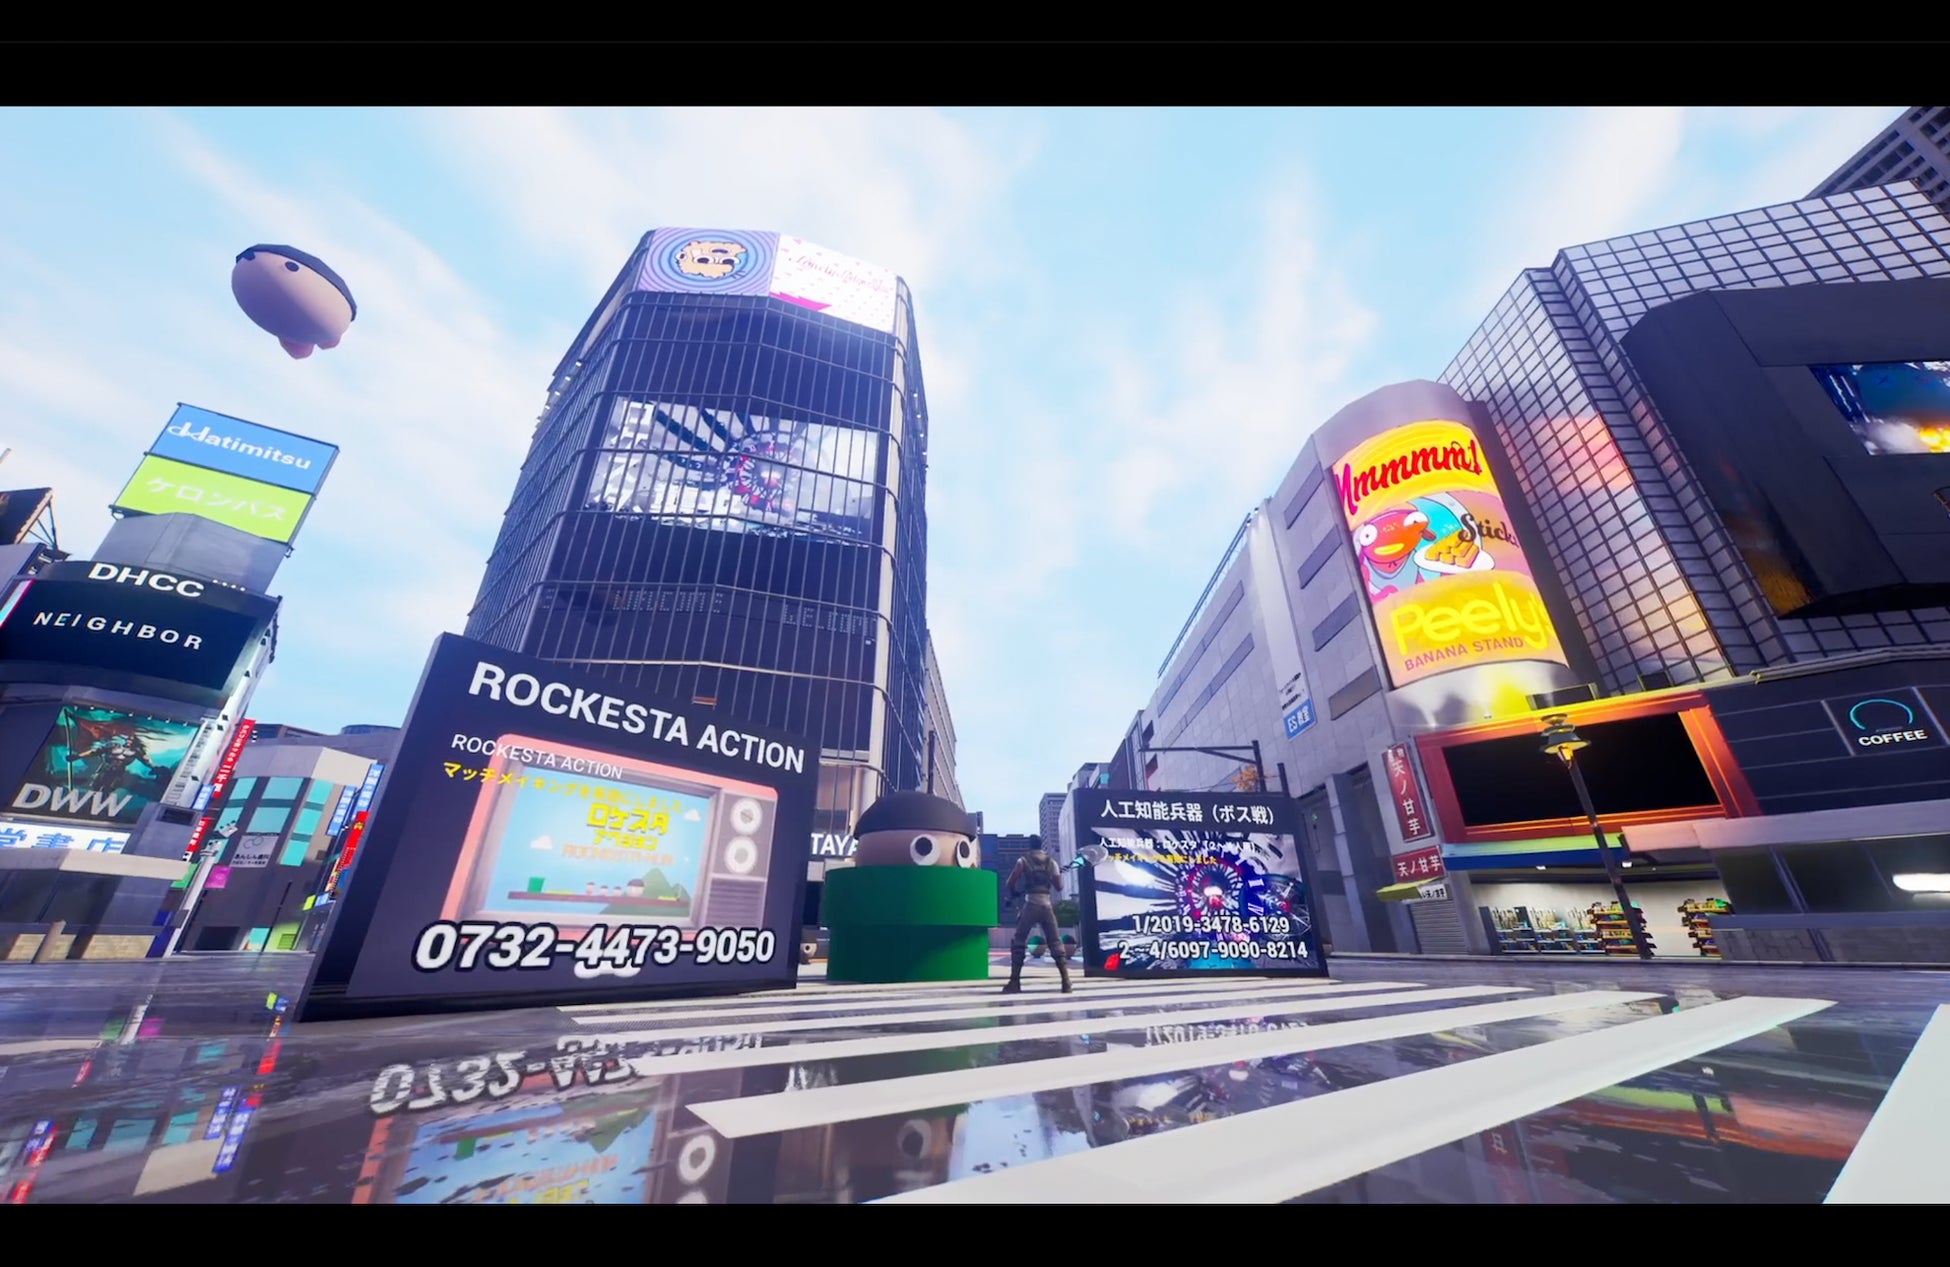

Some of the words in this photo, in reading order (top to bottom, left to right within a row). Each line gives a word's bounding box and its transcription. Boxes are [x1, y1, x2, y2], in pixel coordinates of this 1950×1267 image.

[88, 562, 204, 598] DHCC
[33, 611, 203, 650] NEIGHBOR
[1404, 643, 1468, 671] BANANA
[1472, 637, 1524, 655] STAND
[469, 661, 689, 746] ROCKESTA
[697, 724, 805, 774] ACTION
[1858, 729, 1928, 747] COFFEE
[451, 734, 557, 767] ROCKESTA
[561, 755, 623, 780] ACTION
[12, 783, 133, 817] DWW
[415, 924, 775, 969] 0732-4473-9050
